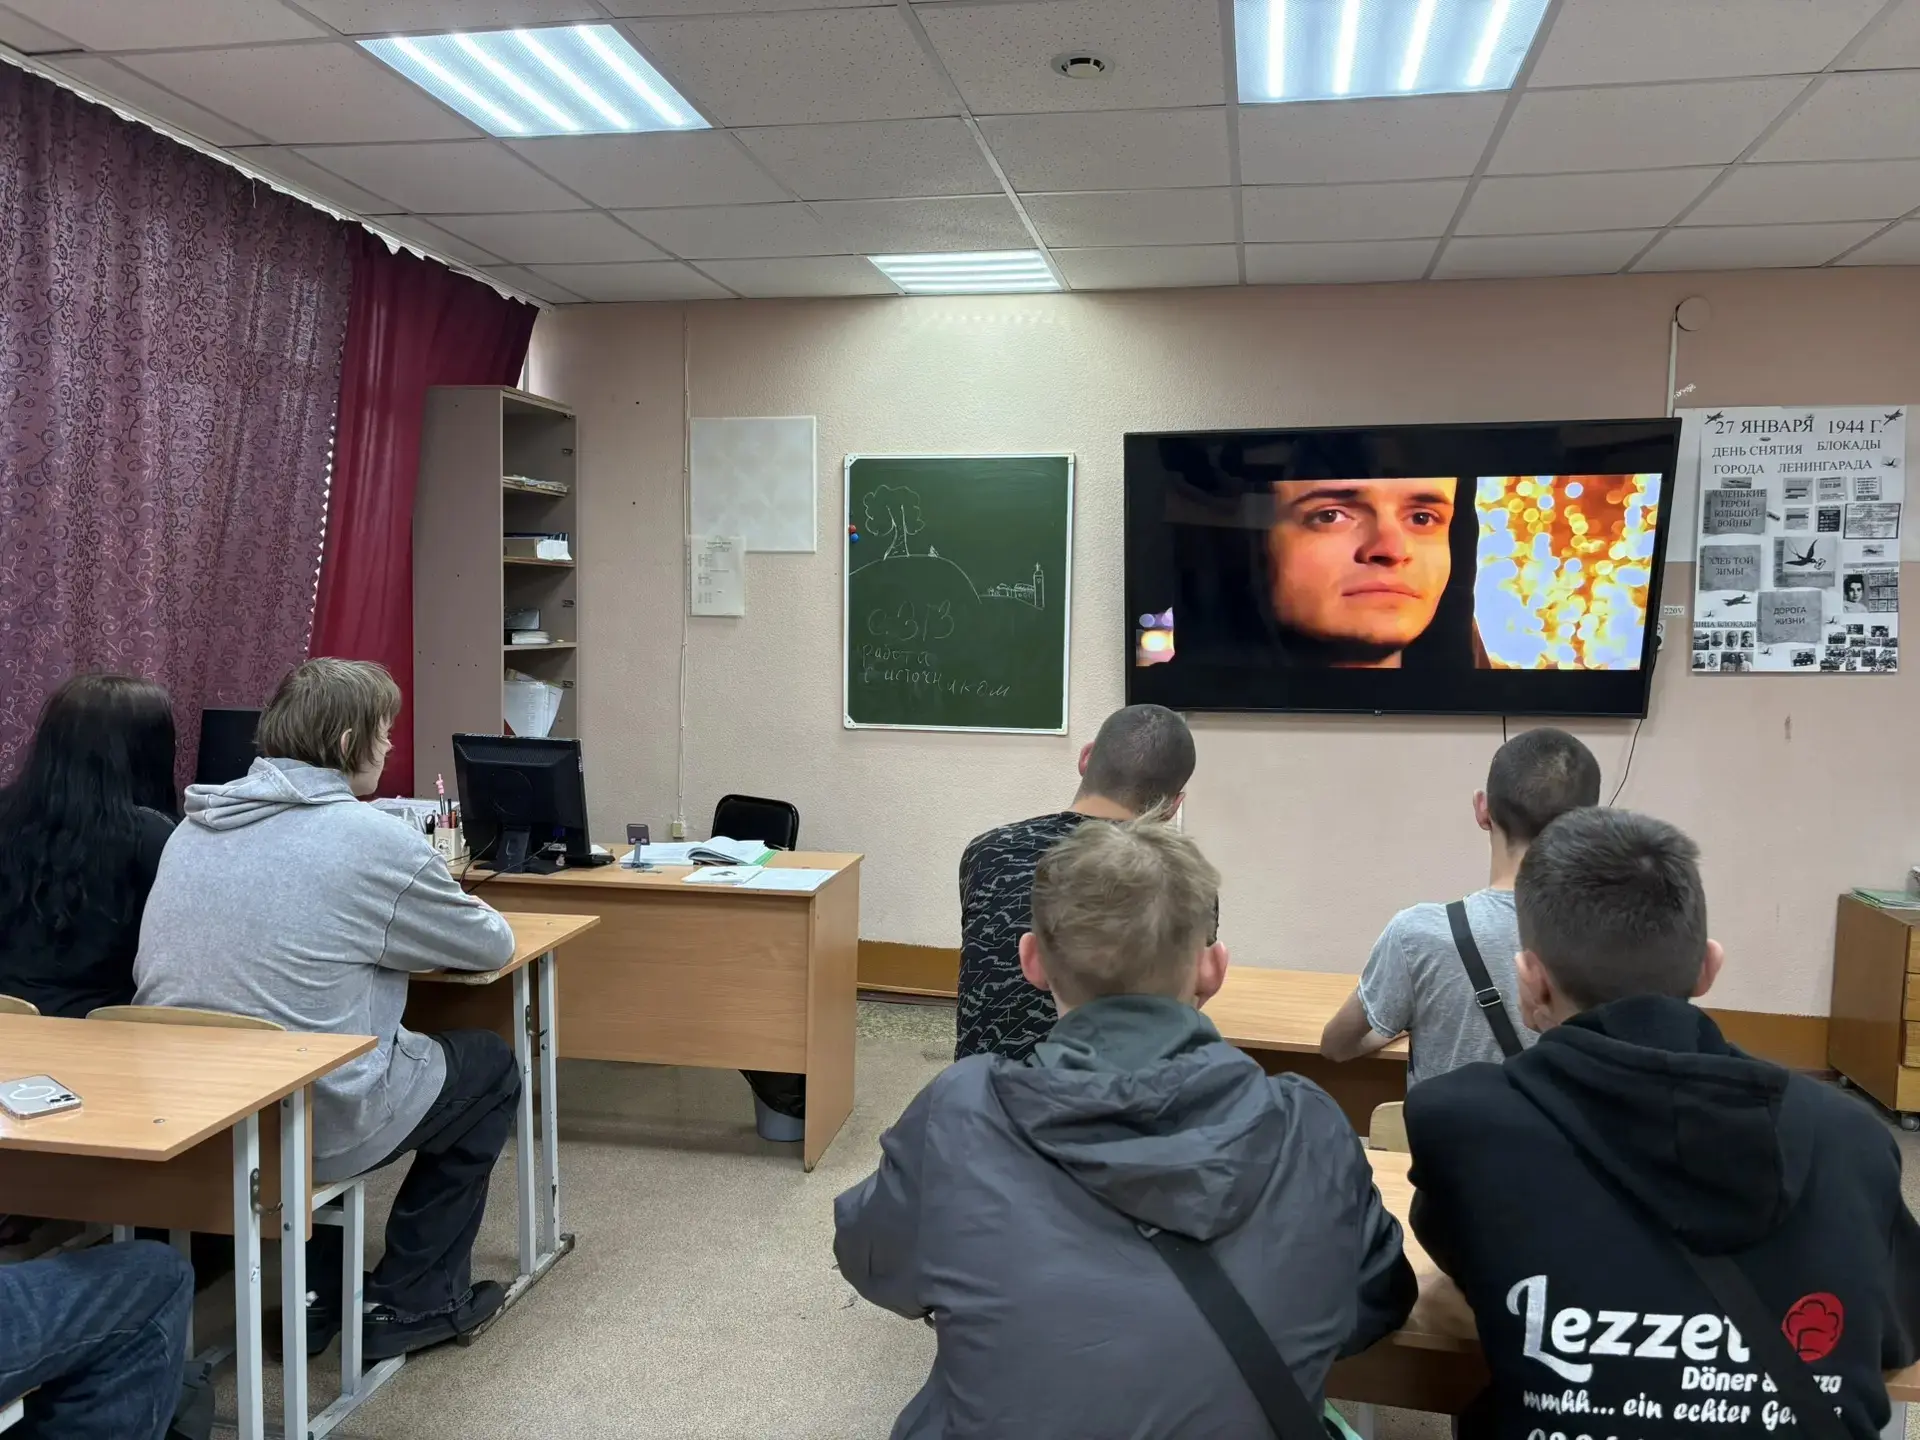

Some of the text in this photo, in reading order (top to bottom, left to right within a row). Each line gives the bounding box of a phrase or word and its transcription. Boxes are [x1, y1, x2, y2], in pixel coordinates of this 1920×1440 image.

[1714, 420, 1735, 435] 27
[1739, 419, 1814, 434] ЯНВАРЯ
[1828, 420, 1865, 434] 1944
[1712, 439, 1881, 458] ДЕНЬ СНЯТИЯ БЛОКАДЫ
[1713, 463, 1765, 475] ГОРОДА
[1715, 567, 1744, 576] ЗИМЫ
[1664, 606, 1684, 615] 220V
[1772, 606, 1807, 616] ДОРОГА
[1774, 617, 1806, 625] ЖИЗНИ
[1682, 1366, 1758, 1393] Döner
[1622, 1392, 1663, 1420] ein
[1673, 1398, 1751, 1424] echter
